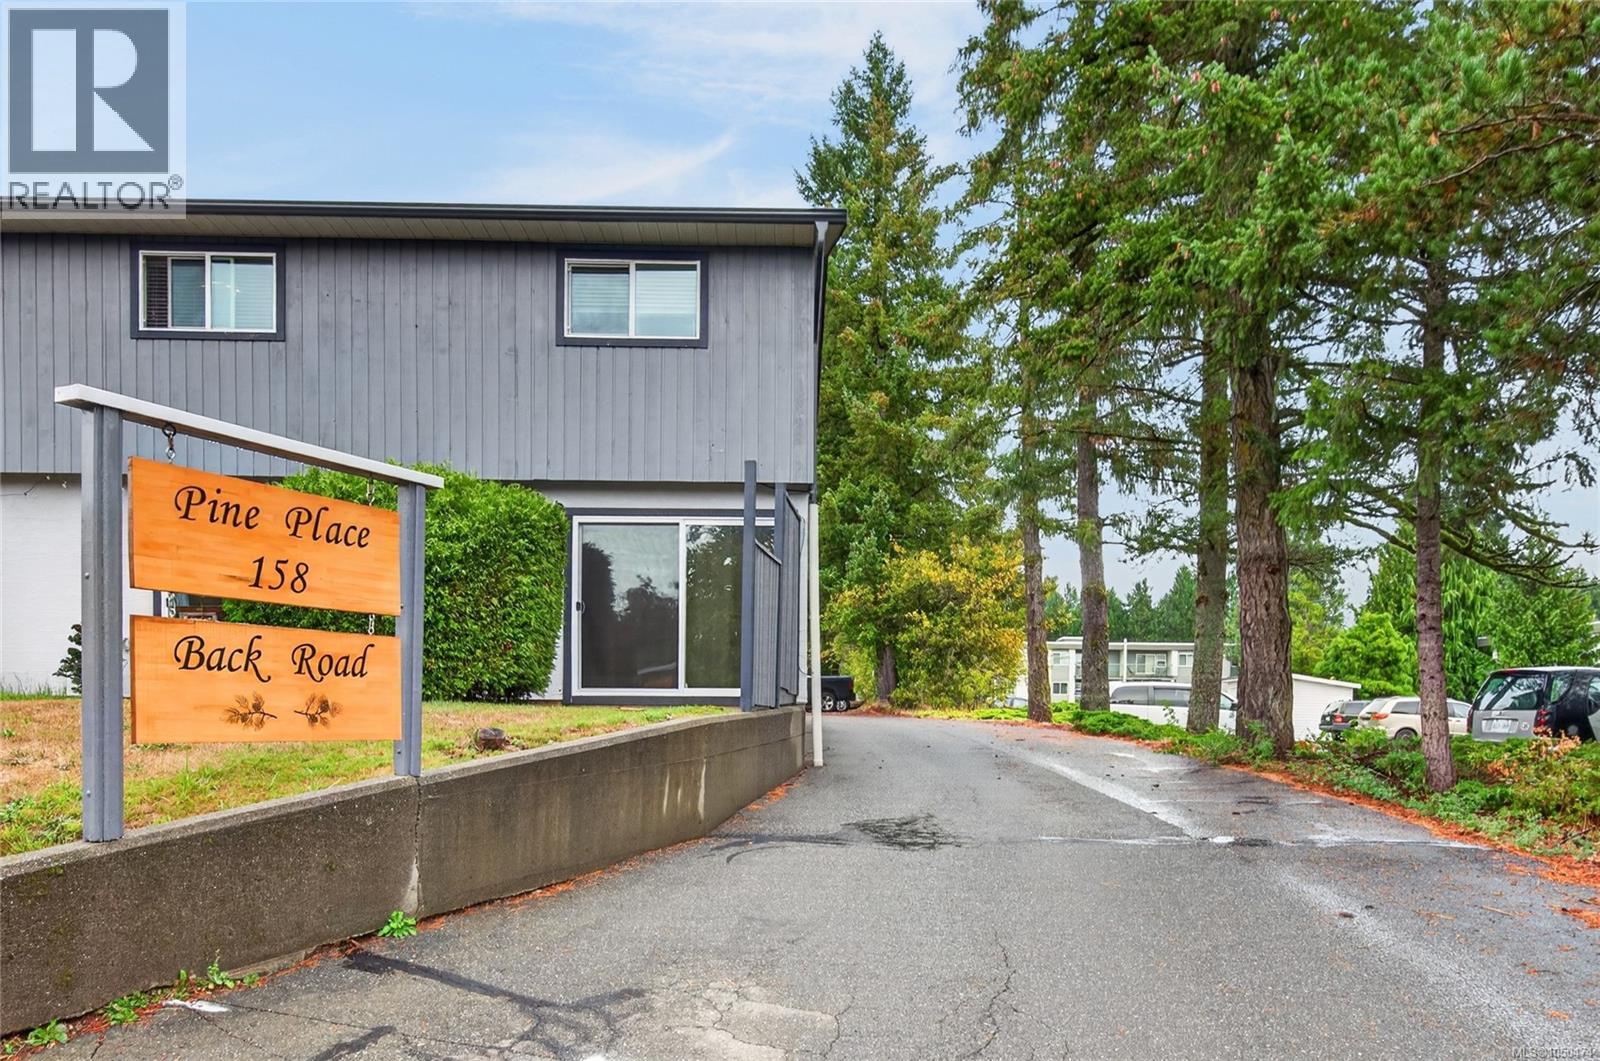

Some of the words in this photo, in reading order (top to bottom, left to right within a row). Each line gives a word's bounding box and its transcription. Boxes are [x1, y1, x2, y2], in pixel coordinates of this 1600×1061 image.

[174, 485, 261, 530] Pine
[285, 506, 371, 548] Place
[249, 556, 309, 594] 158
[174, 635, 271, 683] Back
[291, 643, 375, 683] Road
